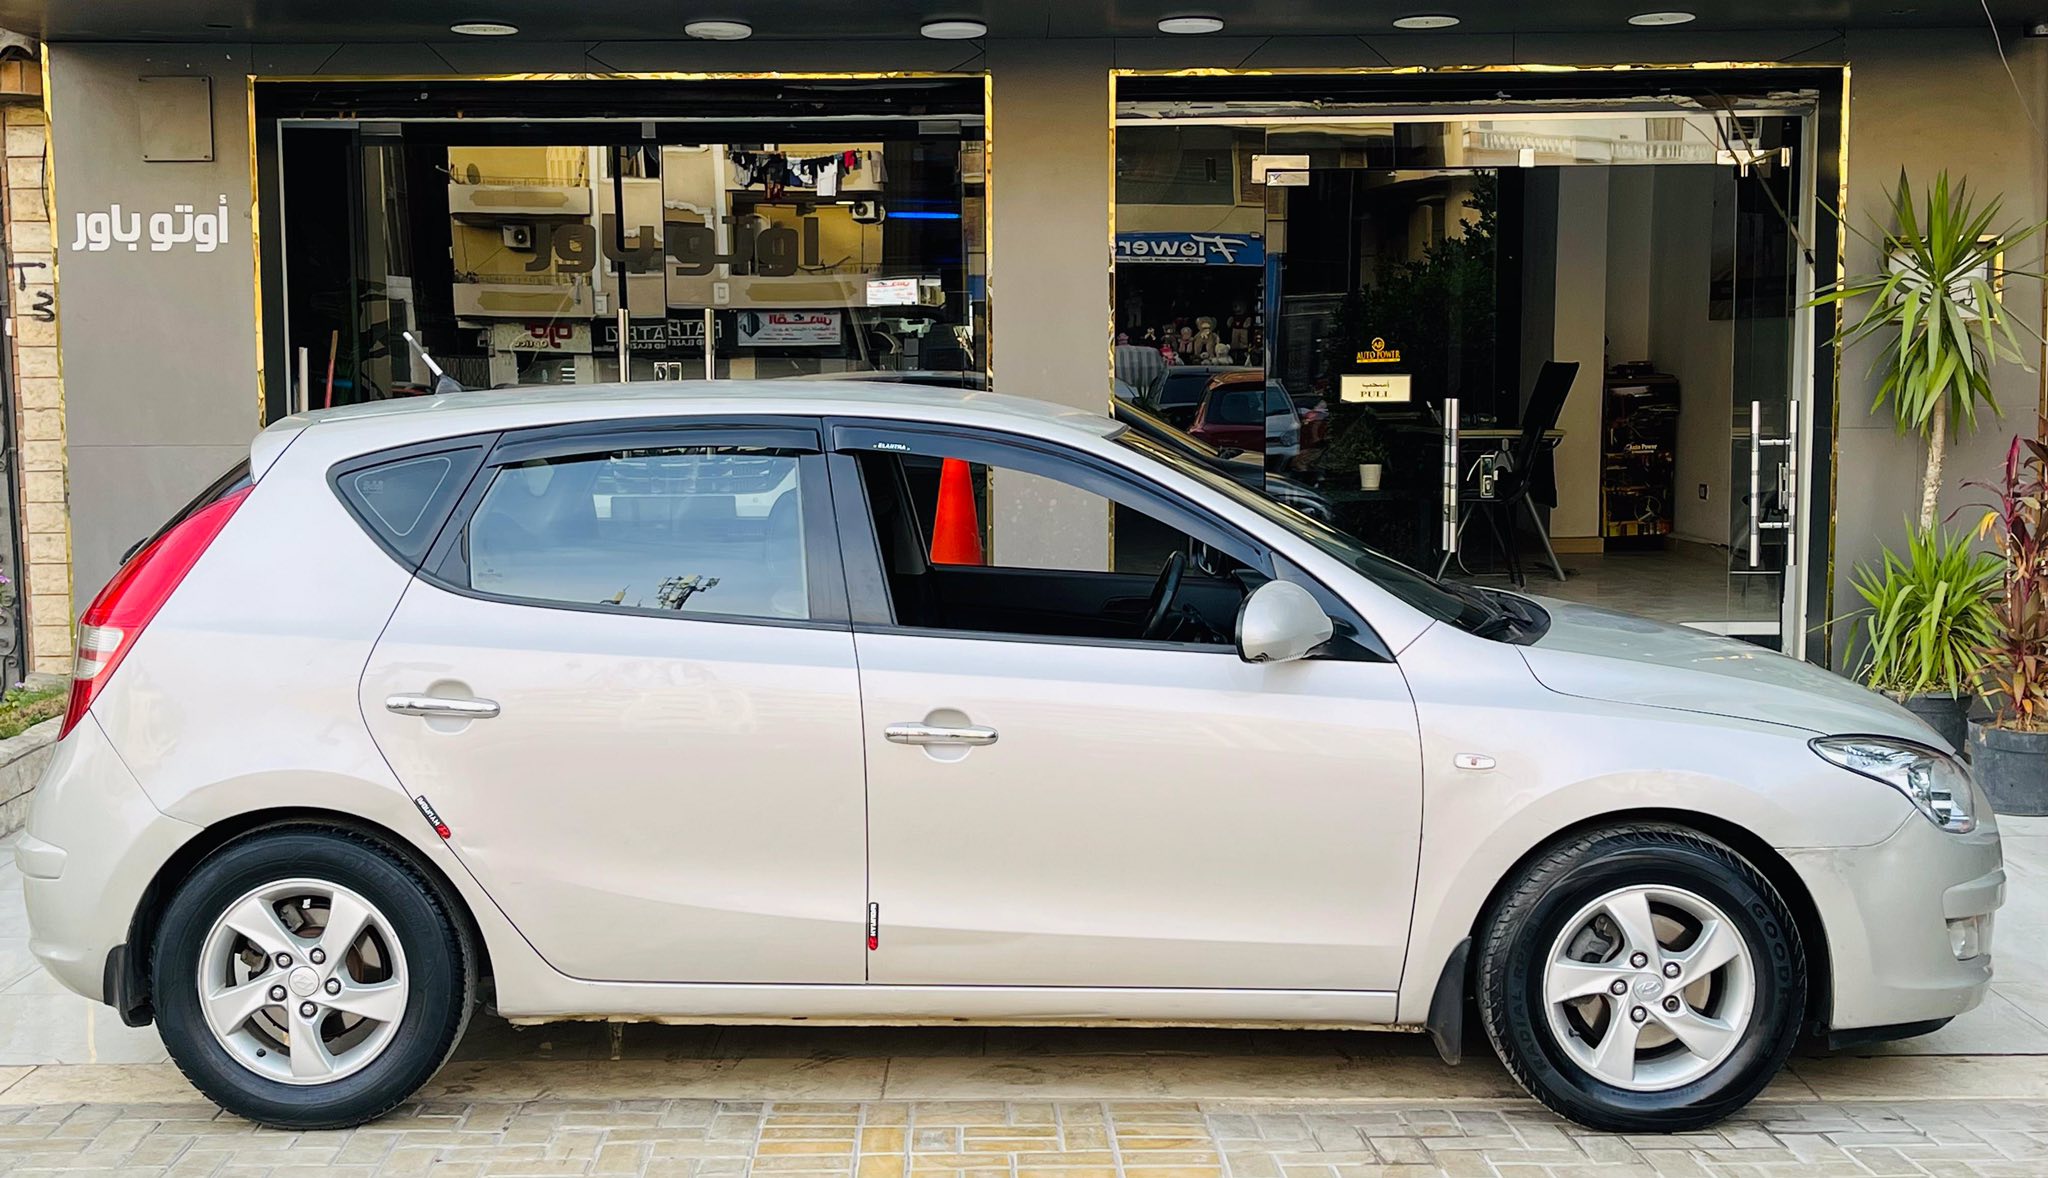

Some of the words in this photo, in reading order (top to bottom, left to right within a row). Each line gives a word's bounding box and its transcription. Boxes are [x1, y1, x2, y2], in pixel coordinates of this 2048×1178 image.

[72, 204, 141, 251] باور
[149, 194, 229, 252] أوتو
[1357, 351, 1376, 360] AUTO
